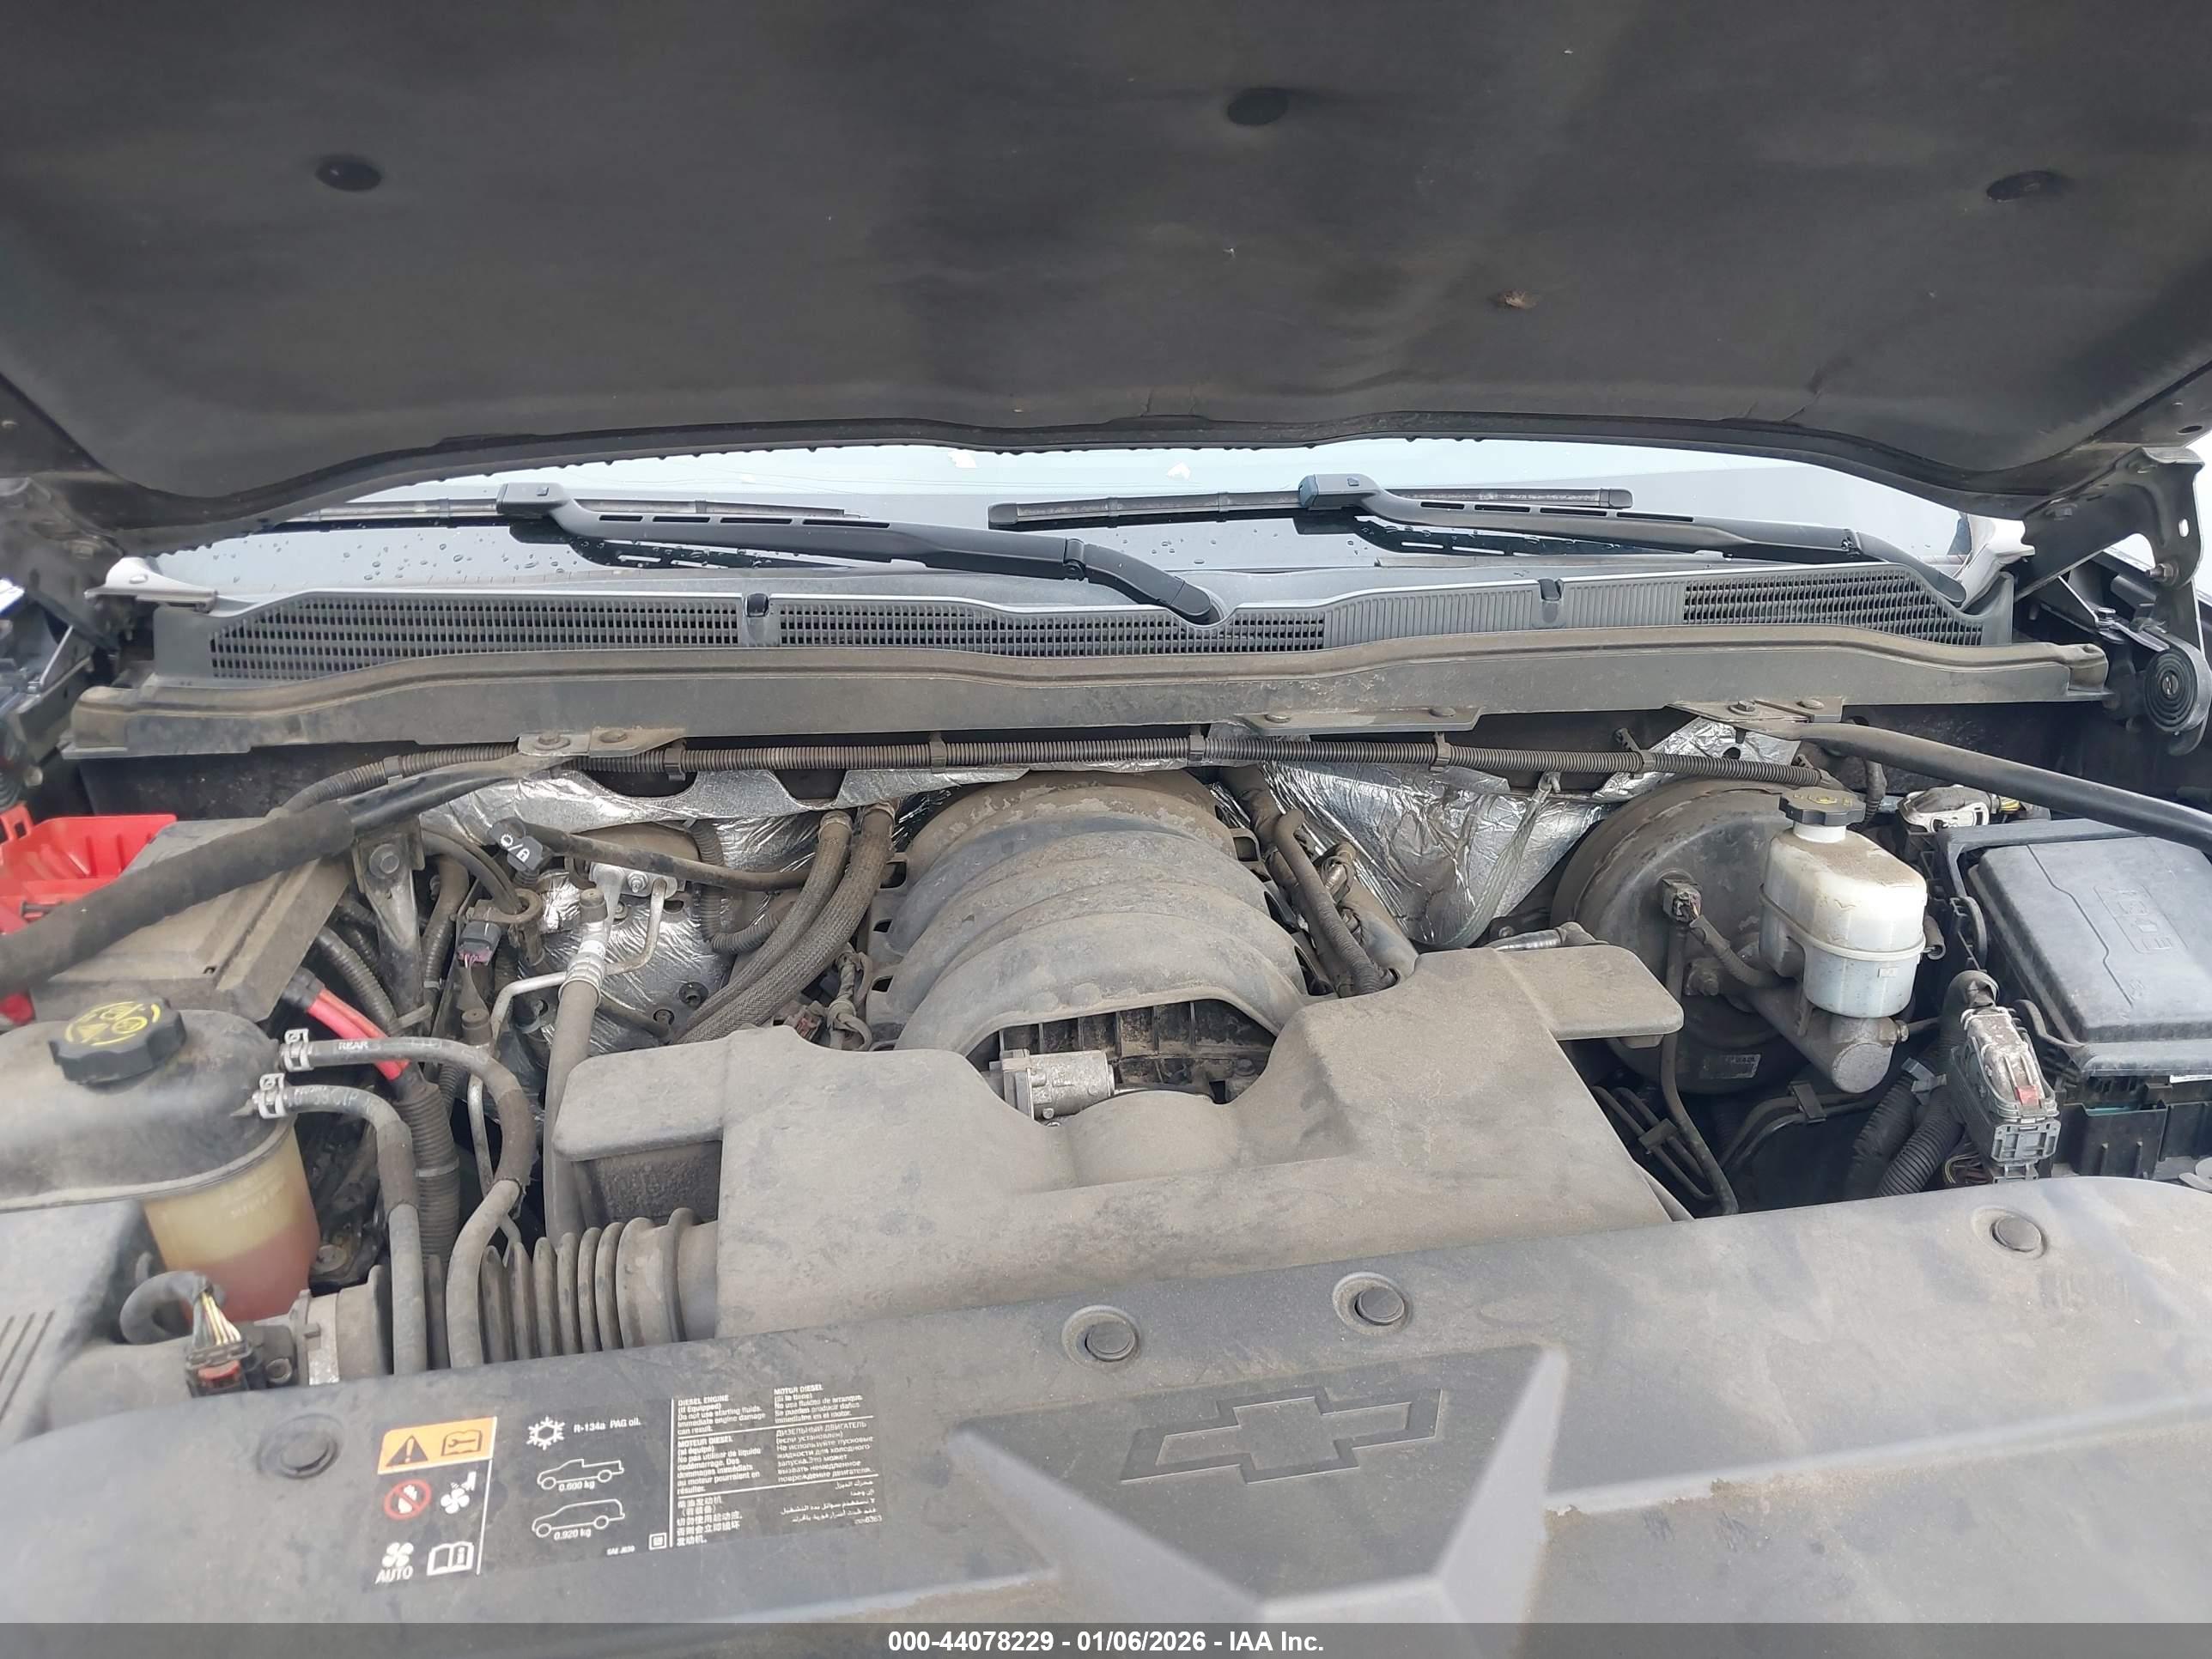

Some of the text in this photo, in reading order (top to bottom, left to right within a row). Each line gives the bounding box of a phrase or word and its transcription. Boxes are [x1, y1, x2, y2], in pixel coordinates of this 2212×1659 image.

[337, 1041, 368, 1050] REAR
[774, 1383, 823, 1395] MOTOR DIESEL
[678, 1394, 729, 1407] DIESEL ENGINE
[714, 1407, 740, 1418] starting
[785, 1407, 810, 1416] pueden
[574, 1417, 641, 1433] R-134a PAG oil.
[678, 1413, 766, 1428] Immediate engine damage
[775, 1421, 867, 1437] ДИЗЕЛЬНЫЙ ДВИГАТЕЛЬ
[678, 1435, 733, 1449] MOTEUR DIESEL
[837, 1436, 873, 1446] пусковые
[689, 1455, 702, 1463] pas
[702, 1451, 727, 1461] utiliser
[677, 1468, 716, 1479] dommages
[688, 1476, 713, 1485] moteur
[714, 1471, 750, 1484] pourraient
[778, 1472, 830, 1483] повреждение
[558, 1480, 595, 1492] 0.600 kg
[554, 1528, 592, 1540] 0.920 kg
[375, 1565, 413, 1584] AUTO
